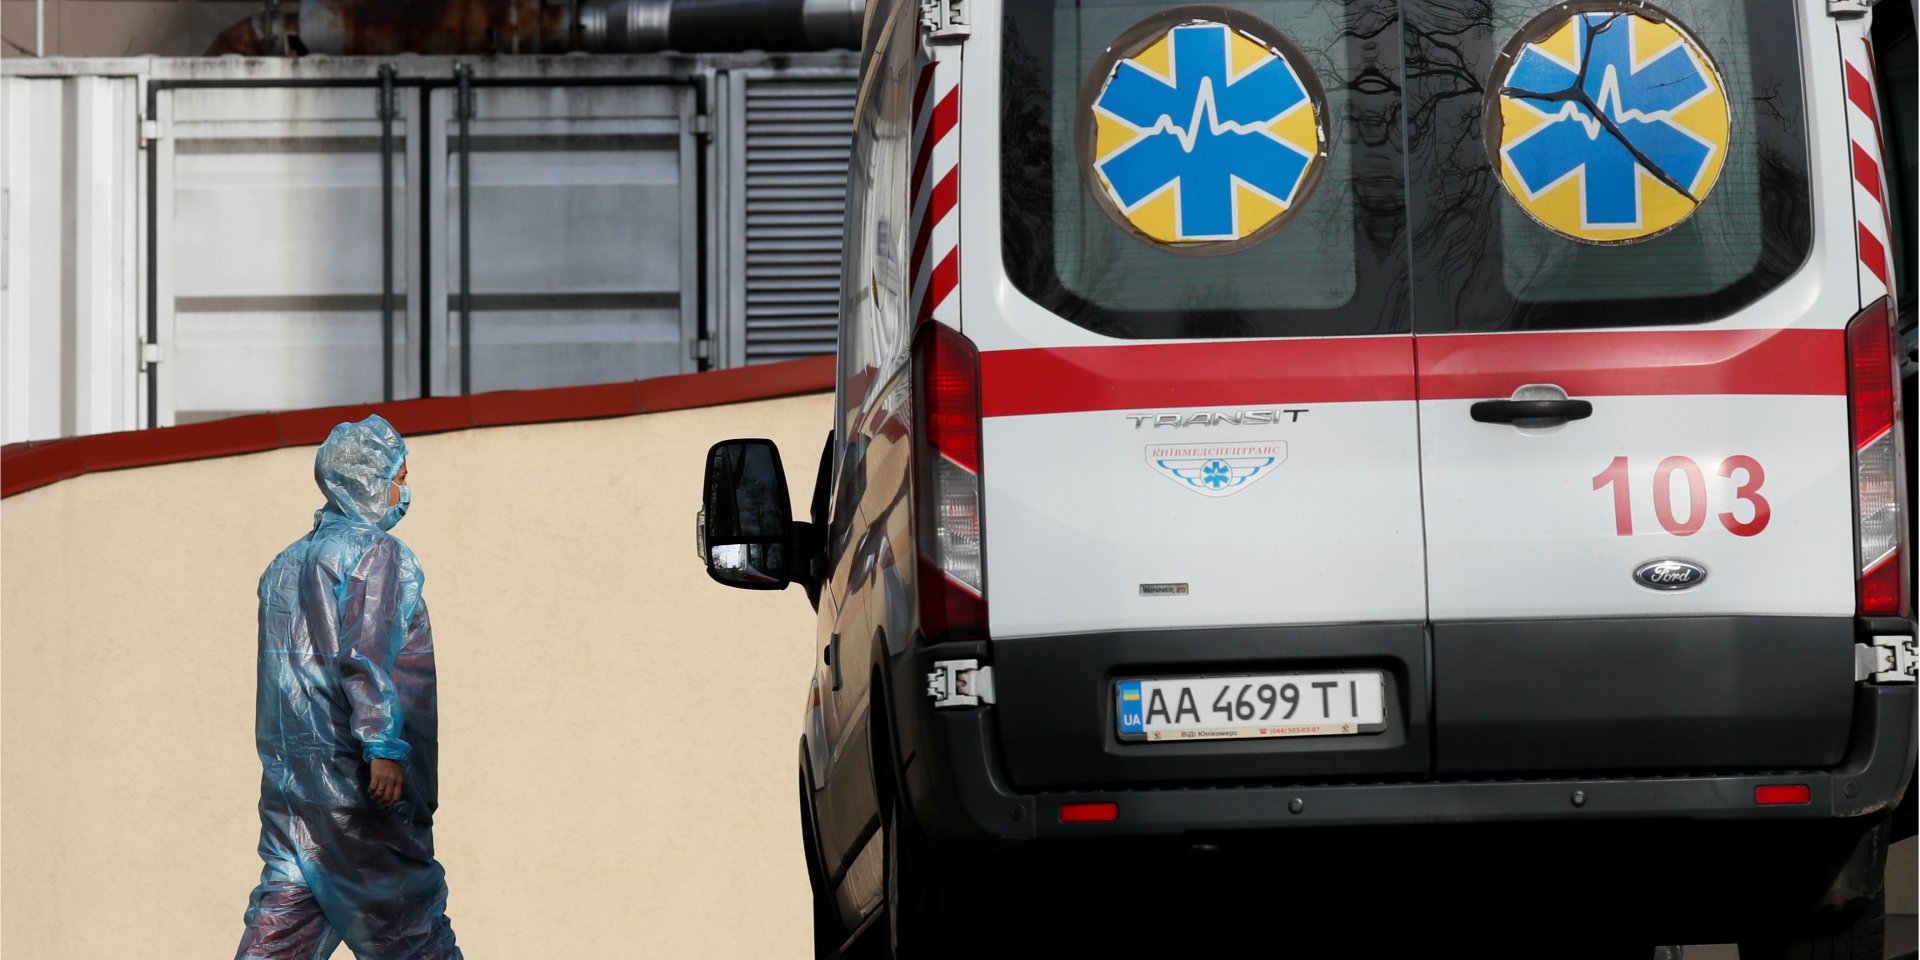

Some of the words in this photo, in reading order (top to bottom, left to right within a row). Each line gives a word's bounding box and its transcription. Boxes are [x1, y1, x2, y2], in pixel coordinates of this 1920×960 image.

[1126, 409, 1309, 429] TRANSIT
[1592, 454, 1771, 537] 103
[1651, 564, 1691, 583] Ford
[1146, 688, 1200, 725] AA
[1213, 683, 1300, 721] 4699
[1311, 681, 1359, 718] TI
[1124, 715, 1141, 725] UA
